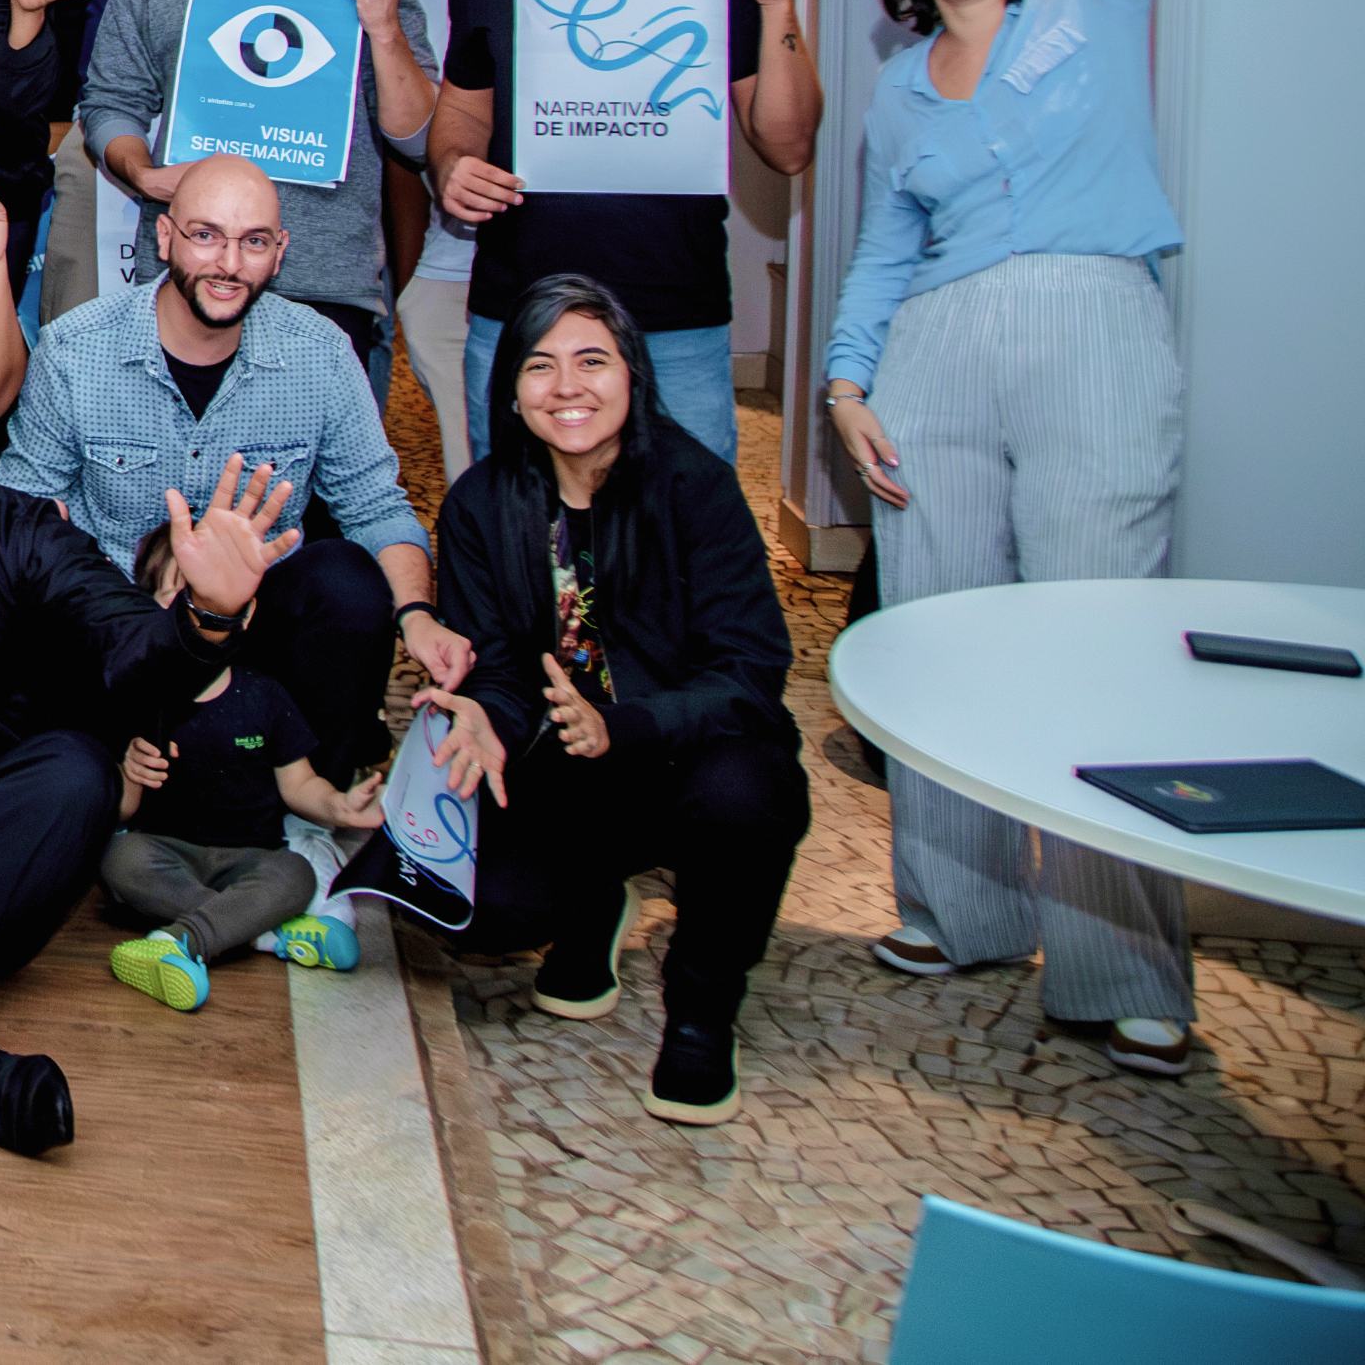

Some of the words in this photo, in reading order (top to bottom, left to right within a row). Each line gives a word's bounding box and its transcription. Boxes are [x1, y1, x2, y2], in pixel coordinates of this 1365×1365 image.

[534, 100, 671, 117] NARRATIVAS
[260, 125, 328, 148] VISUAL
[534, 121, 564, 137] DE
[569, 121, 669, 137] IMPACTO
[190, 135, 326, 167] SENSEMAKING
